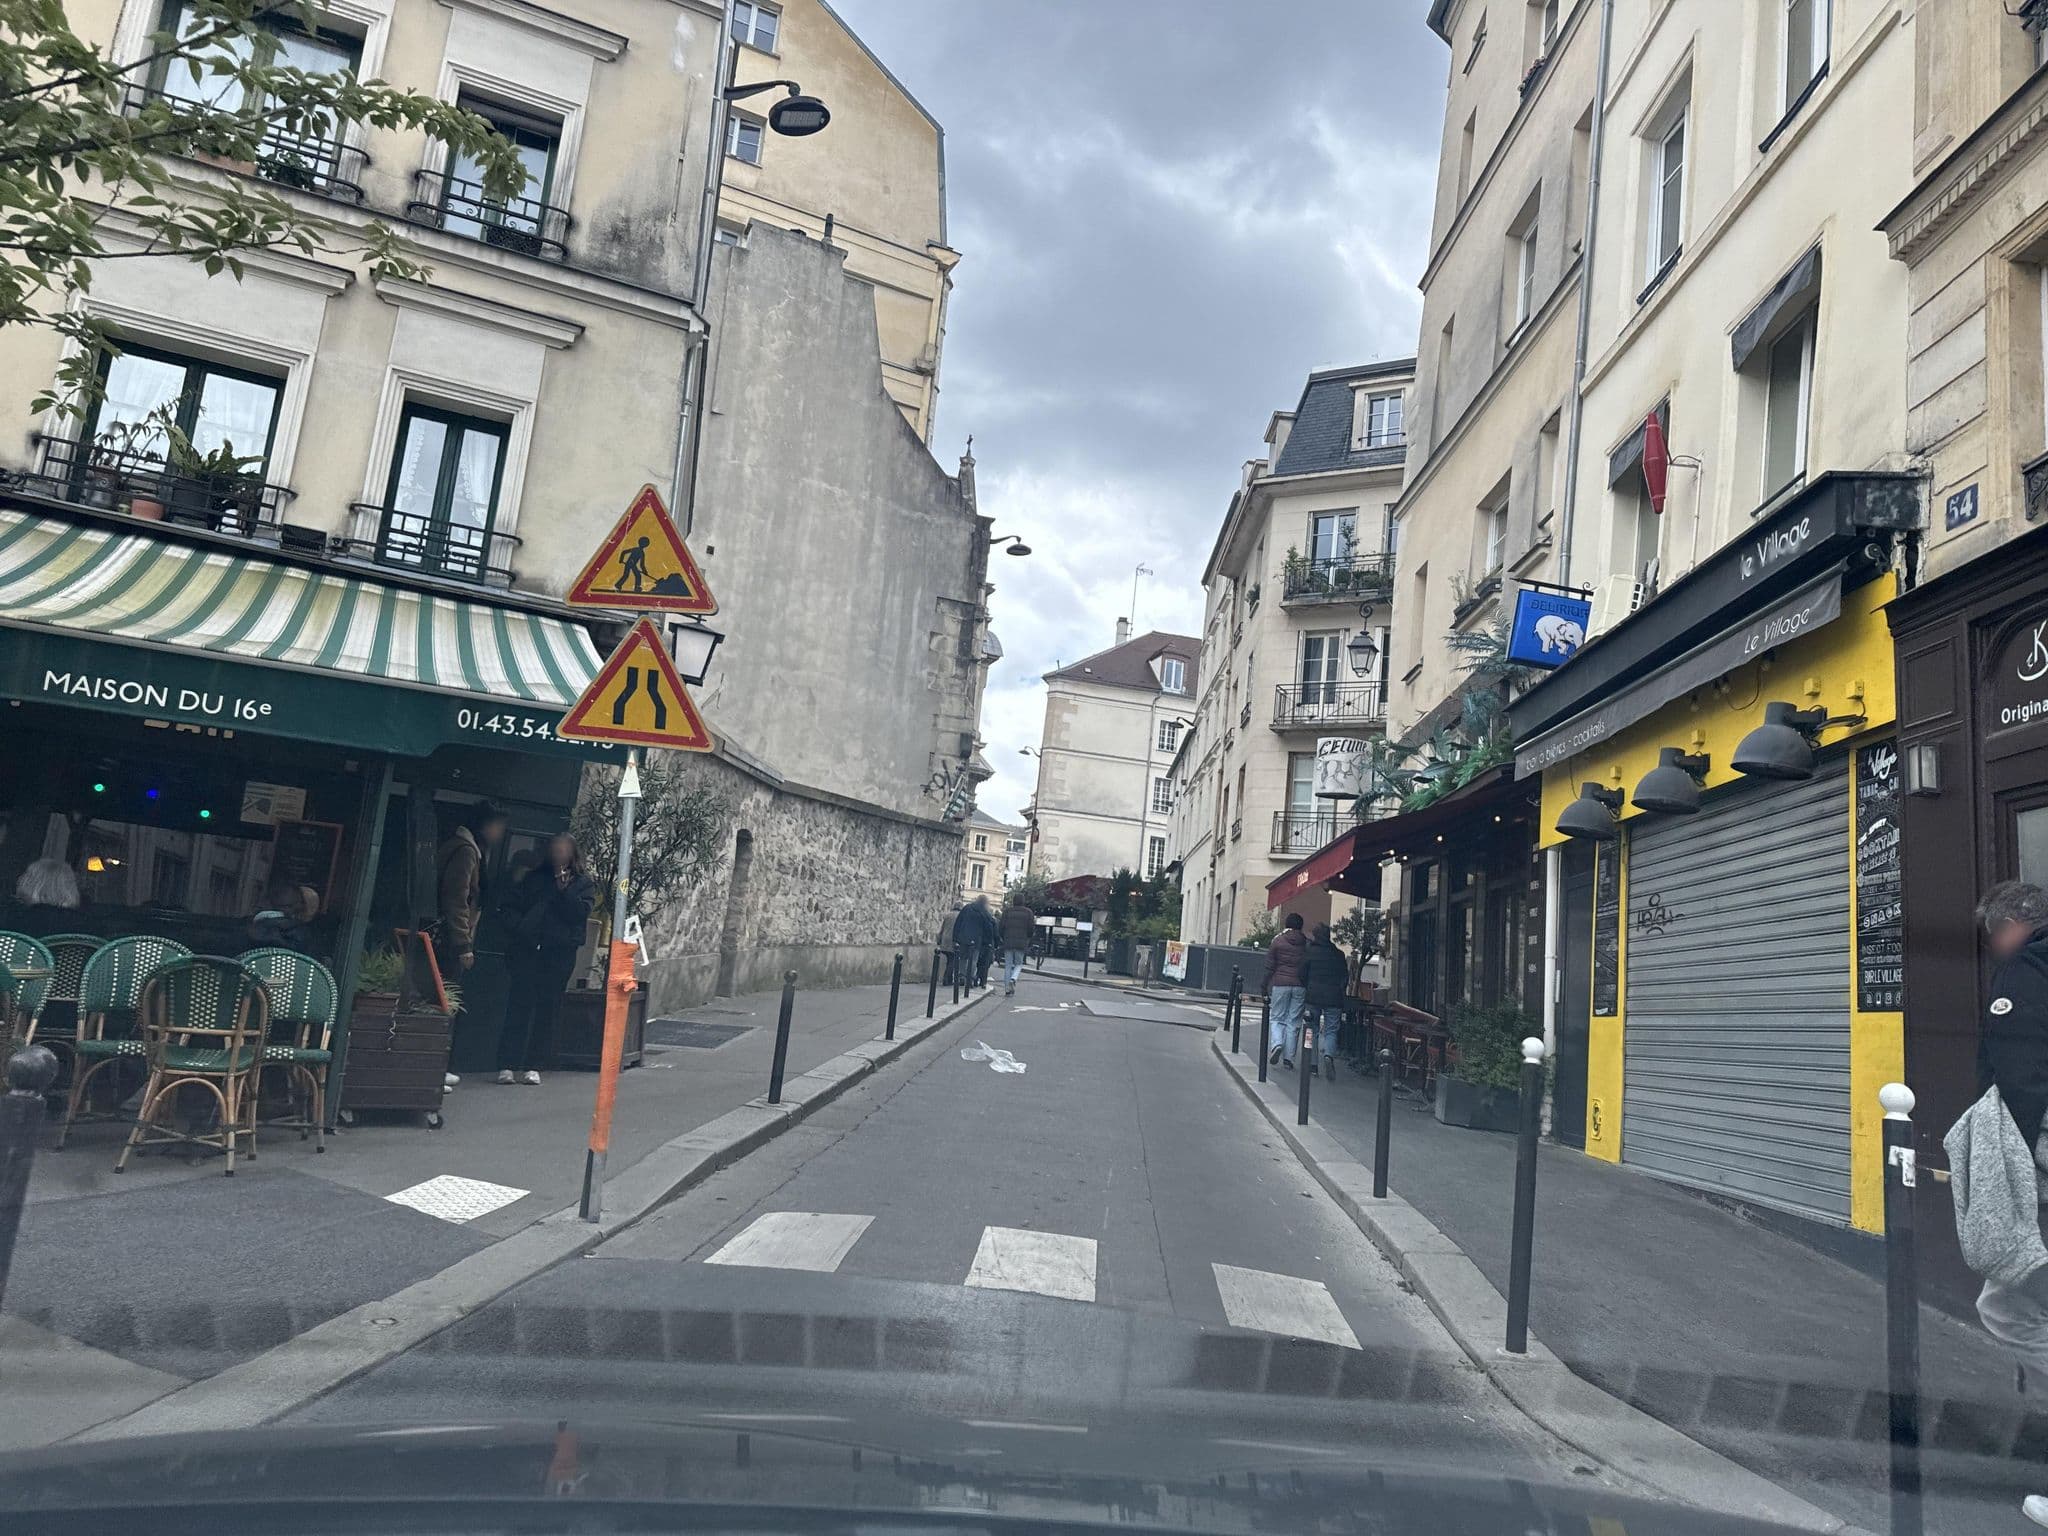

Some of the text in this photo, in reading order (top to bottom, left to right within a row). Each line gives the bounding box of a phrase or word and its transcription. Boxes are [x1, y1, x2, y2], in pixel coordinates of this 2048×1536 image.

[1949, 489, 1973, 524] 54
[1756, 517, 1810, 567] Village
[1744, 607, 1810, 654] Le Village
[43, 670, 273, 720] MAISON DU 16e
[1863, 903, 1902, 927] SNACK
